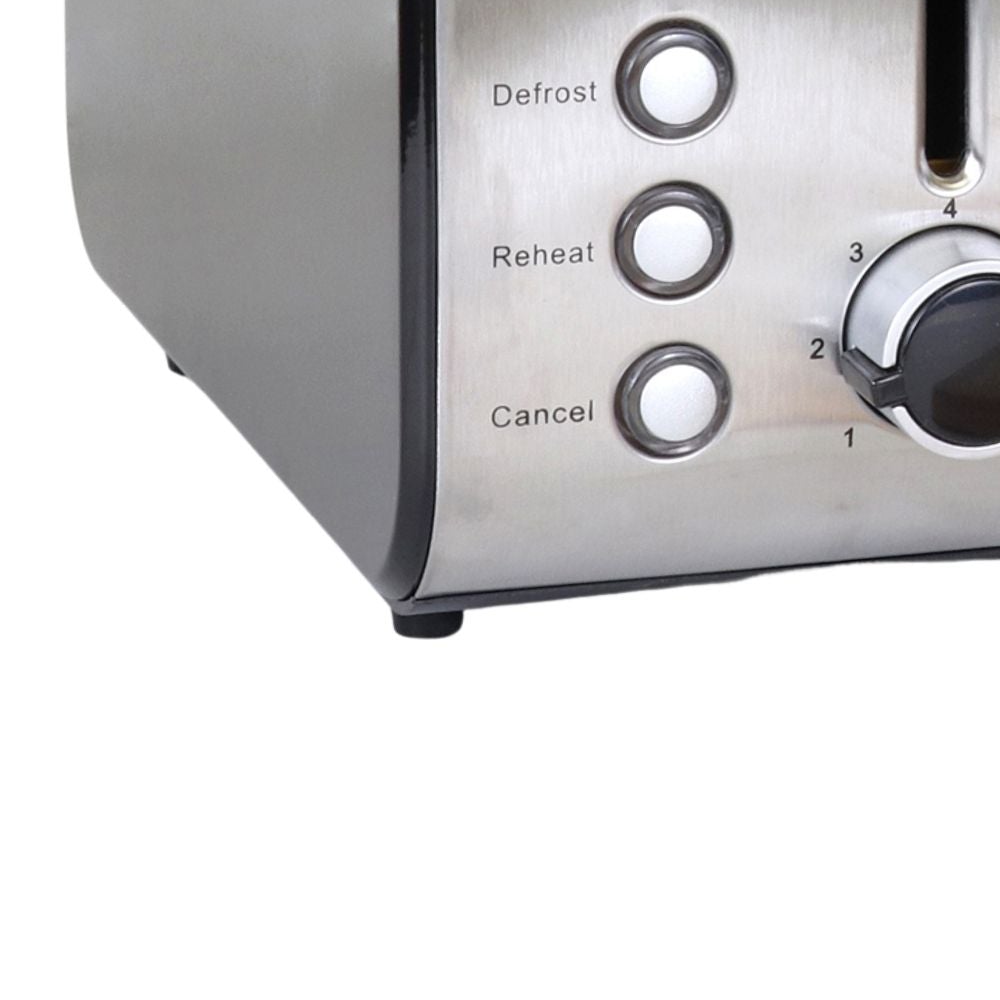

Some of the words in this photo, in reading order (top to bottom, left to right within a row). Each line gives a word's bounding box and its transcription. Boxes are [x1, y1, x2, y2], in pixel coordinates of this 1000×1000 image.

[493, 81, 597, 107] Defrost
[942, 197, 957, 218] 4
[493, 241, 594, 268] Reheat
[849, 242, 864, 263] 3
[809, 337, 825, 360] 2
[491, 399, 594, 428] Cancel
[843, 427, 855, 448] 1
